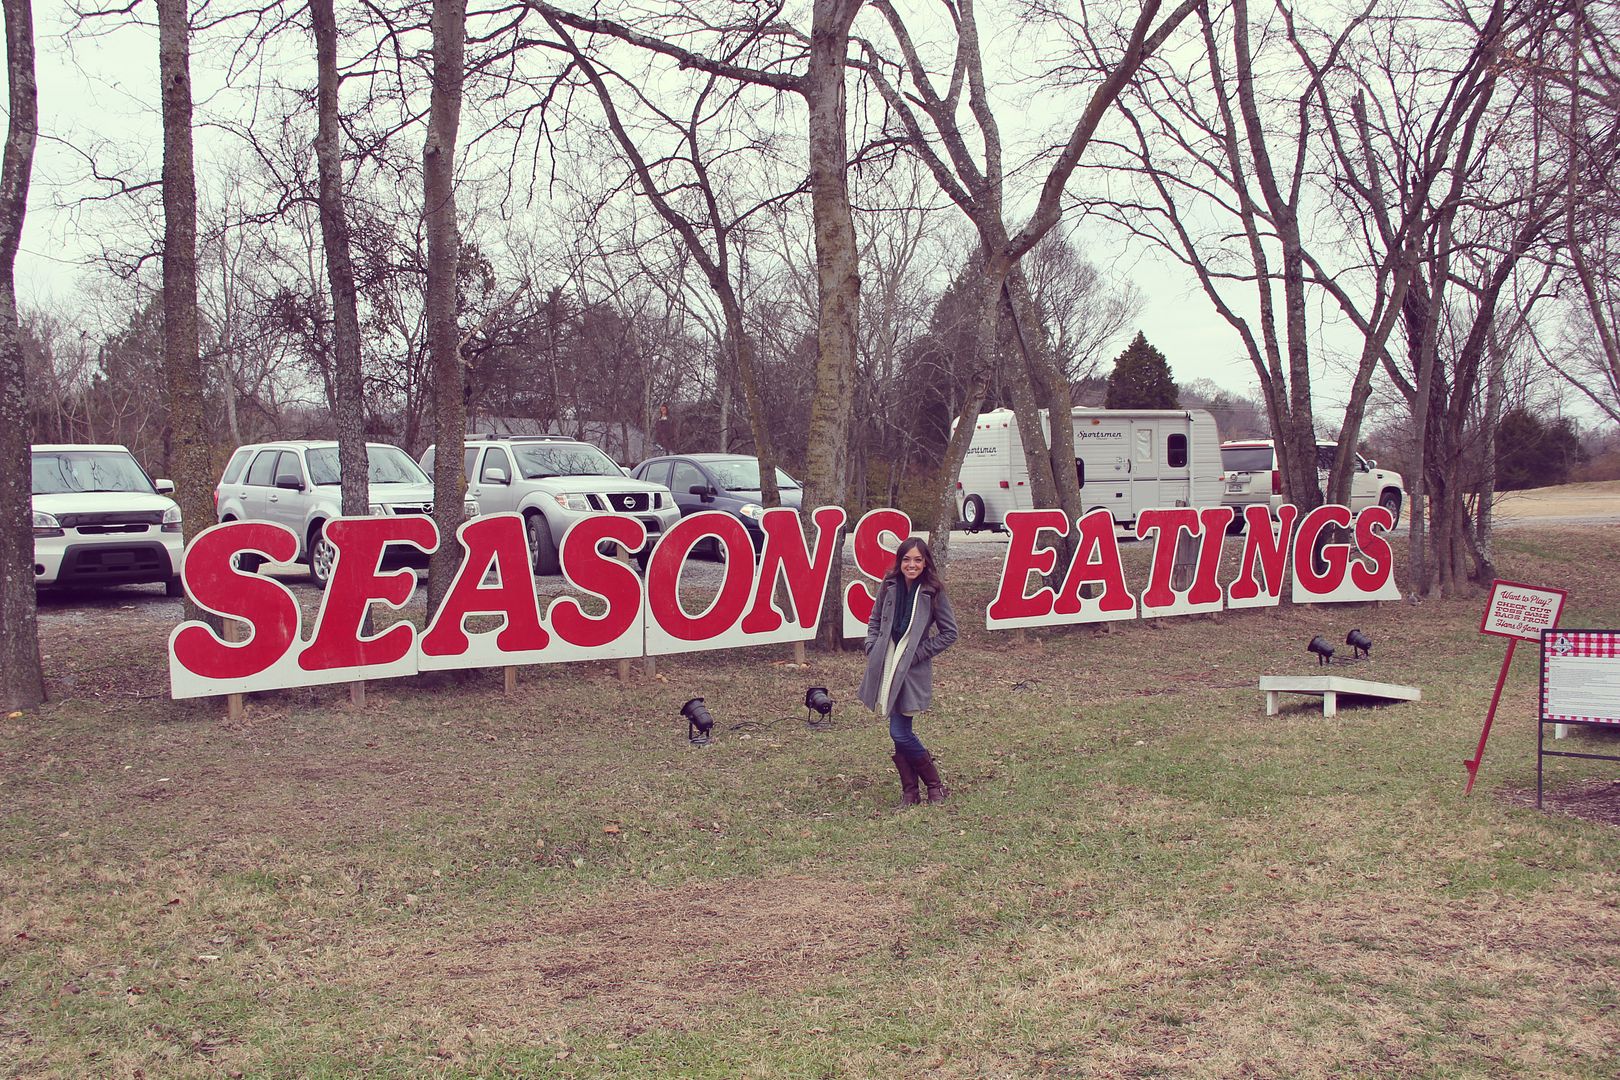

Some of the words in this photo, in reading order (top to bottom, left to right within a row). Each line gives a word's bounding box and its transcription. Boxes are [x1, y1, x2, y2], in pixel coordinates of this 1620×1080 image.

[1077, 431, 1122, 440] Sportsmen
[171, 507, 913, 680] SEASONS
[989, 505, 1394, 621] EATINGS
[1500, 590, 1521, 601] Want
[1529, 594, 1553, 607] Play?
[1495, 606, 1522, 615] TOSS
[1524, 611, 1550, 619] GAME
[1496, 600, 1527, 610] CHECK
[1529, 606, 1552, 614] OUT
[1494, 611, 1521, 621] BAGS
[1522, 616, 1549, 625] FROM
[1521, 624, 1540, 633] Jams
